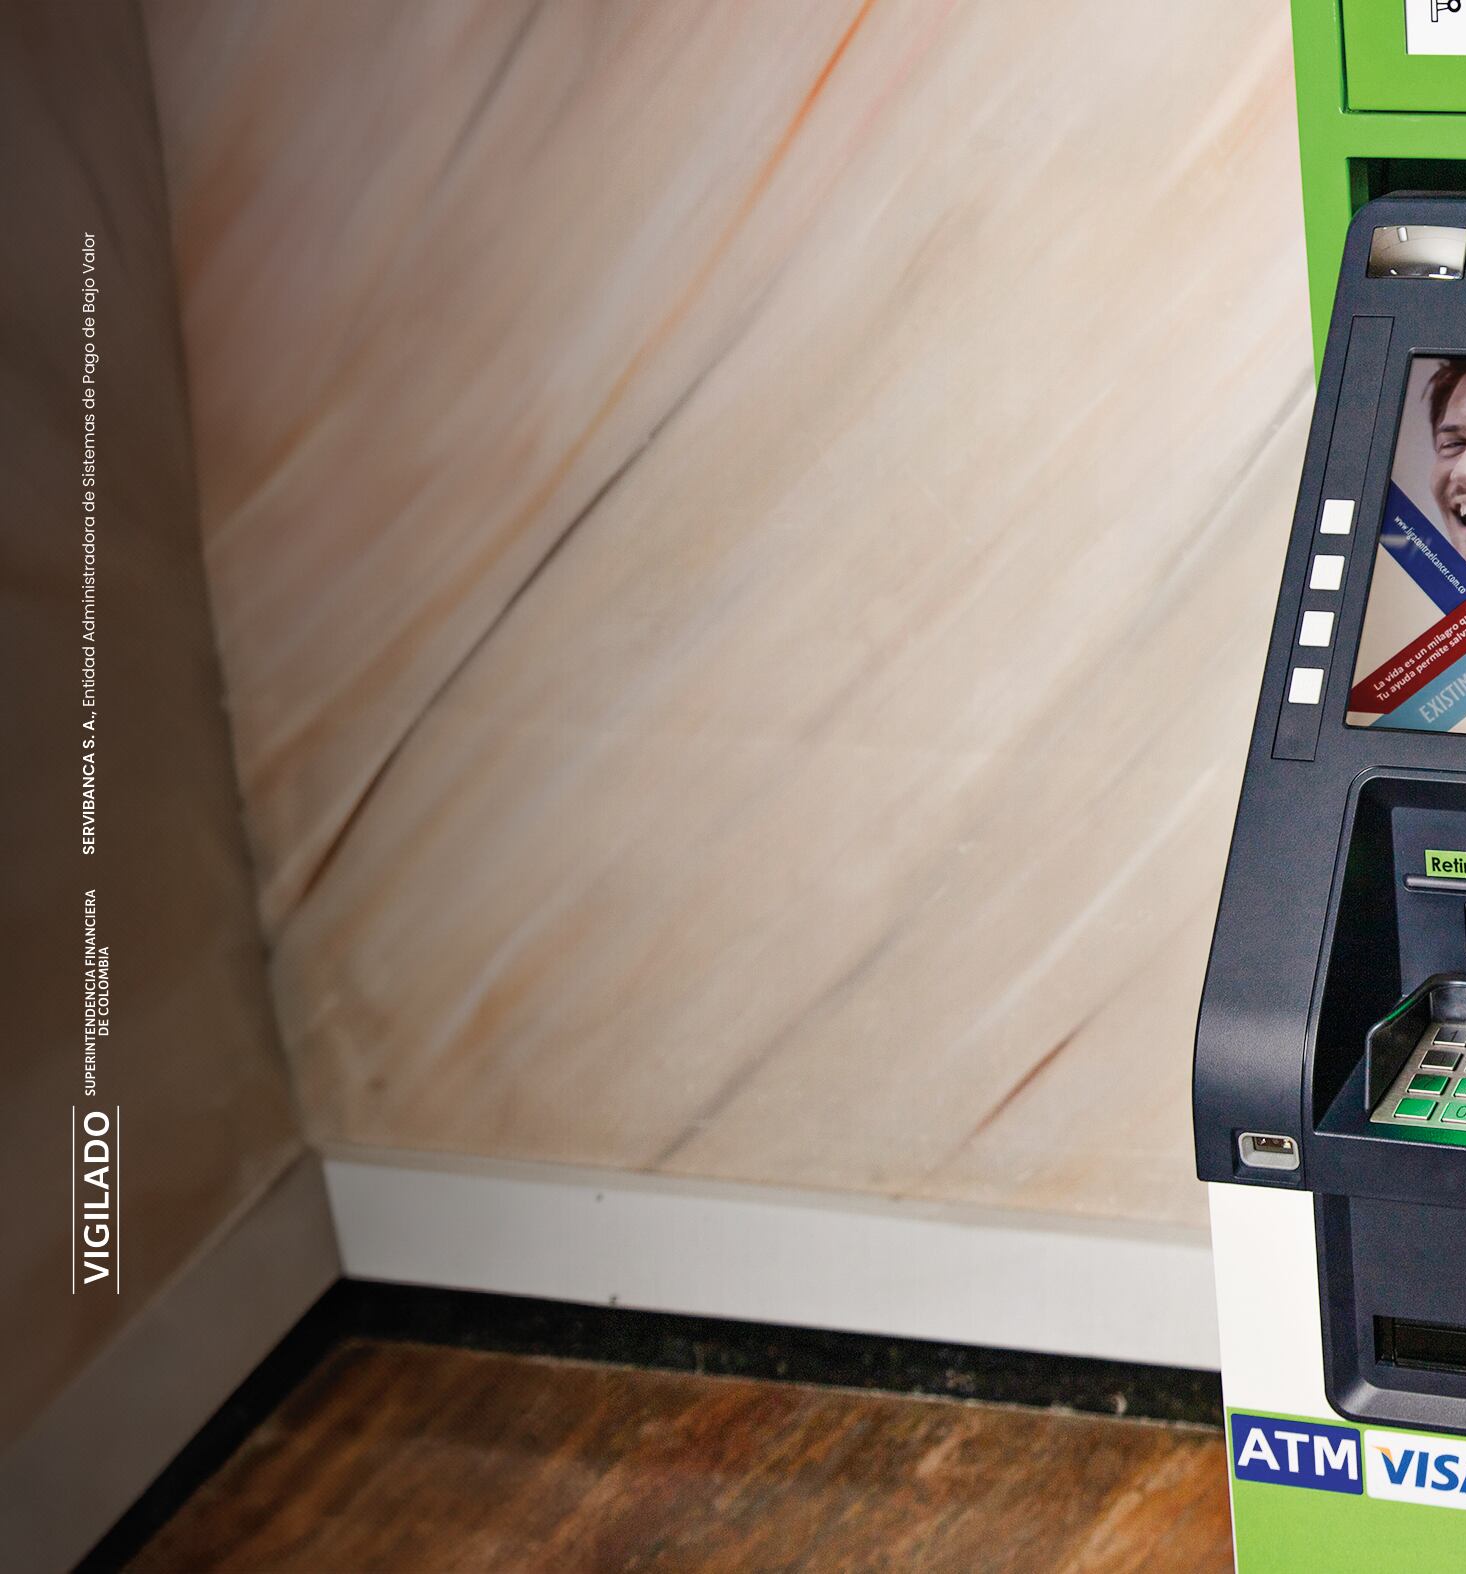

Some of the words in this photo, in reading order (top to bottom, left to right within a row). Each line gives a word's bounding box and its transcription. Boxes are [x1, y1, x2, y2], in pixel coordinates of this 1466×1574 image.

[1394, 515, 1466, 594] www.ligacontraelcancer.com.co
[1373, 682, 1386, 692] La
[1385, 666, 1404, 683] vida
[1404, 657, 1416, 668] es
[1415, 648, 1427, 660] un
[1428, 623, 1459, 651] milagro
[1377, 690, 1390, 702] Tu
[1390, 671, 1416, 693] ayuda
[1416, 645, 1450, 674] permite
[1450, 1030, 1459, 1042] 1
[1237, 1427, 1359, 1482] ATM
